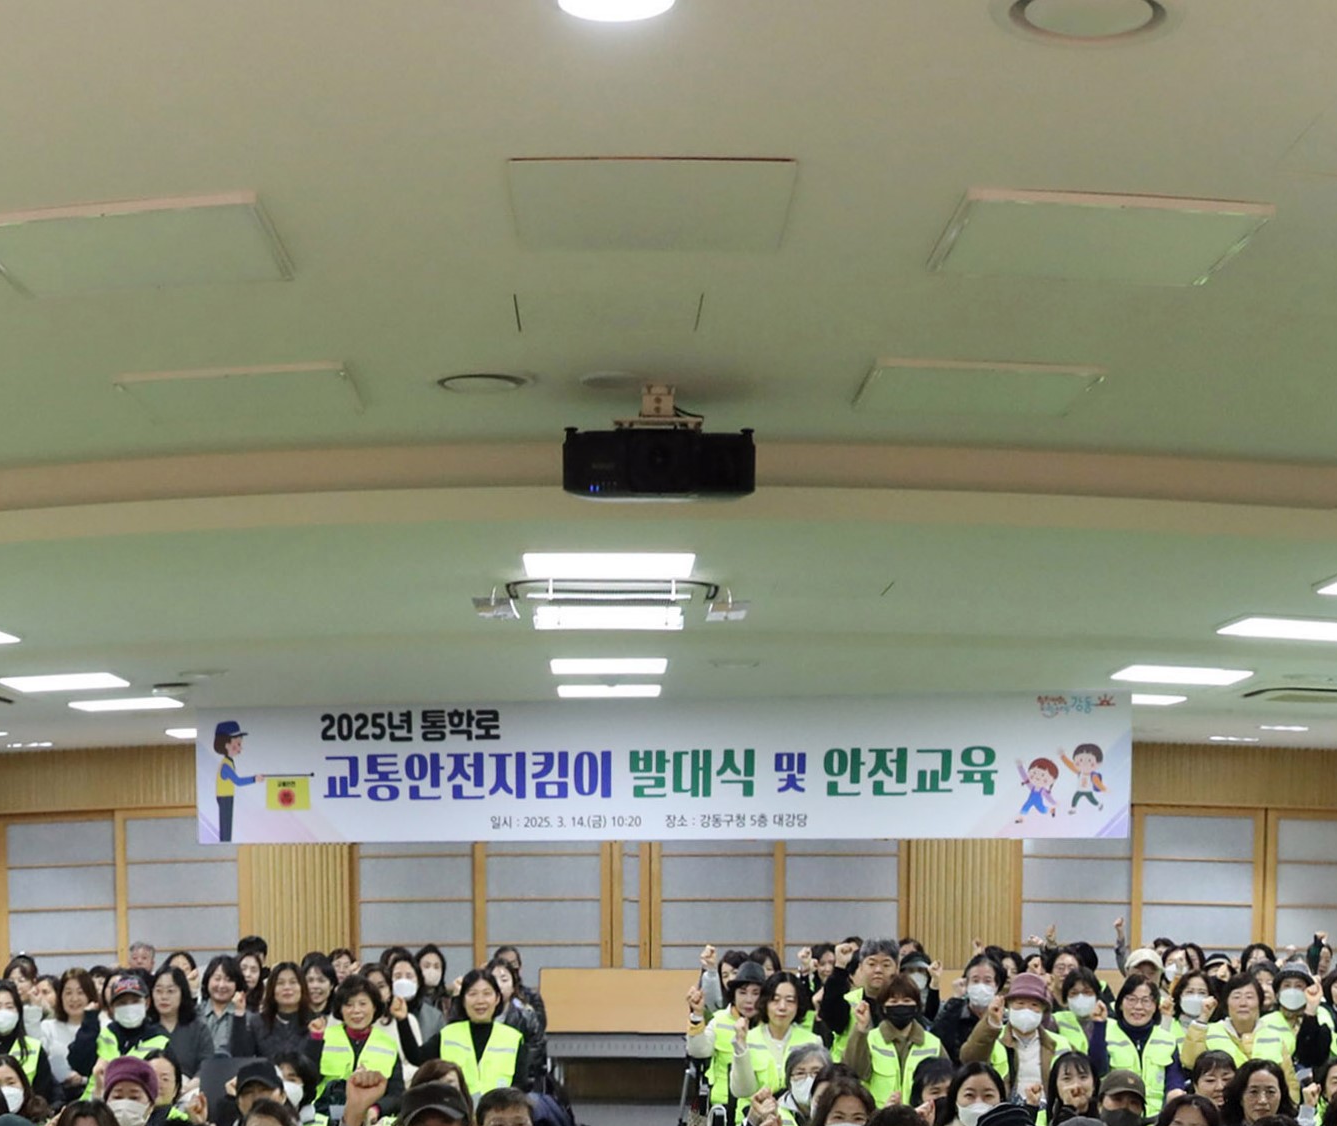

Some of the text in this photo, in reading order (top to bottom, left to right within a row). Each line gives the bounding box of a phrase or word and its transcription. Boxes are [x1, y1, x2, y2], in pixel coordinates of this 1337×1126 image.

[321, 708, 500, 742] 2025년 통학로
[324, 746, 998, 801] 교통안전지킴이 발대식 및 안전교육
[491, 816, 512, 829] 일시
[524, 816, 553, 828] 2025.
[557, 816, 566, 828] 3.
[572, 815, 607, 828] 14.(금)
[612, 816, 641, 827] 10:20
[666, 815, 687, 828] 장소
[701, 814, 745, 828] 강동구청
[750, 814, 768, 827] 5층
[773, 813, 807, 827] 대강당
